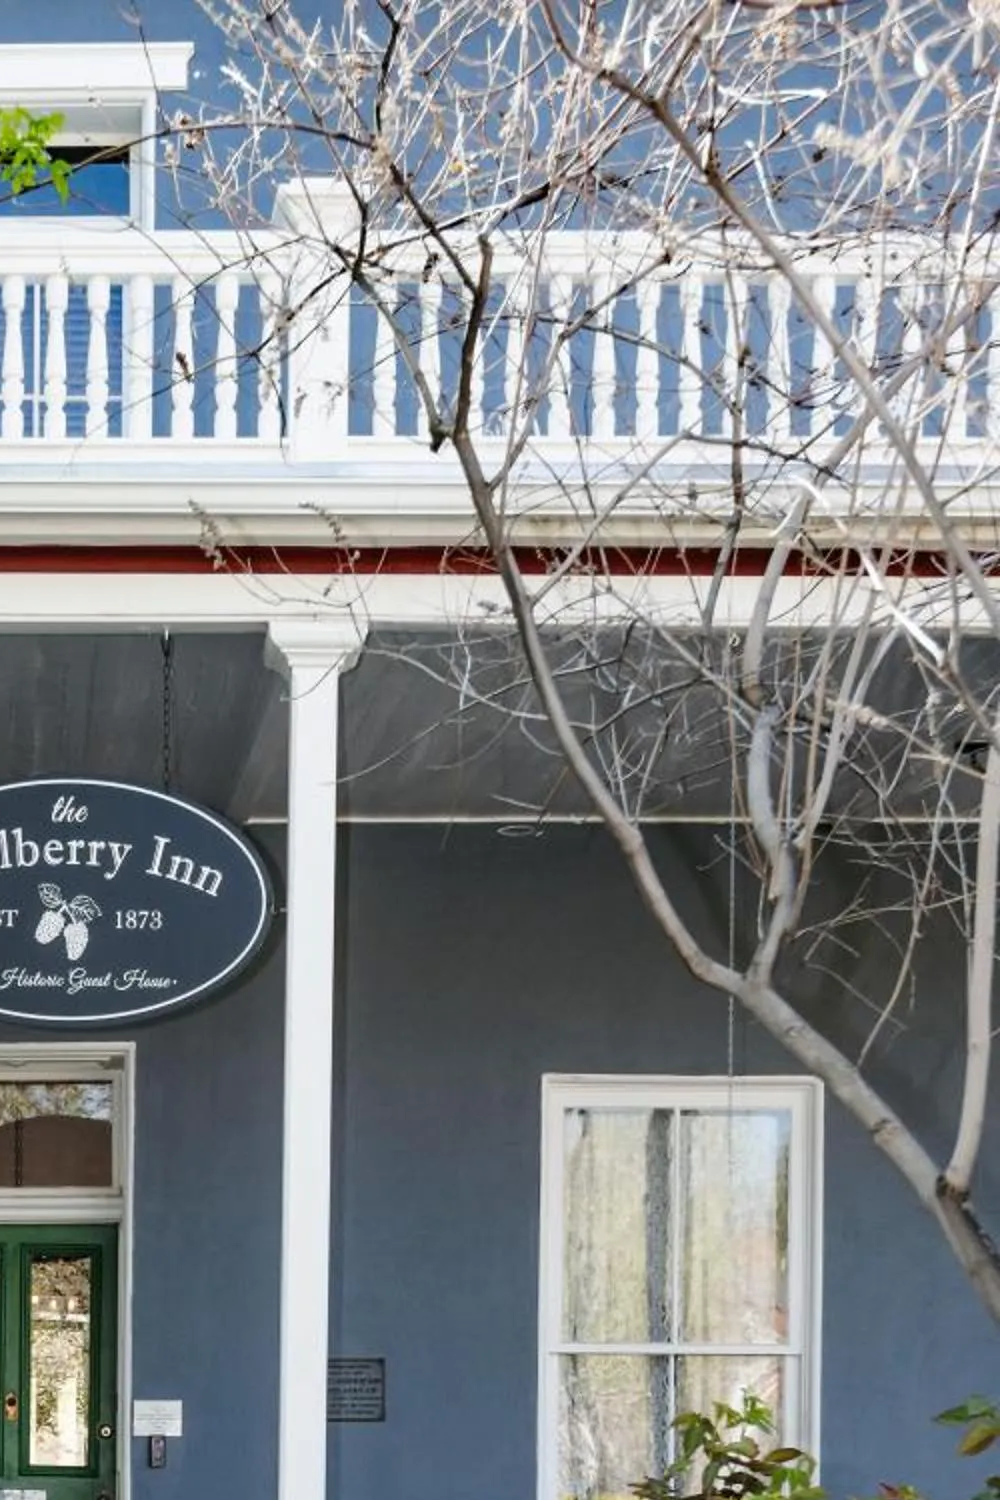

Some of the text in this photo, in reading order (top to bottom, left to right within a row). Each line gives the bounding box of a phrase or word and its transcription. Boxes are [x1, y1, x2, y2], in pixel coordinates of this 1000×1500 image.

[51, 795, 89, 823] the
[145, 835, 223, 897] Inn
[114, 911, 163, 930] 1873
[66, 967, 113, 995] Guest
[114, 968, 171, 991] House
